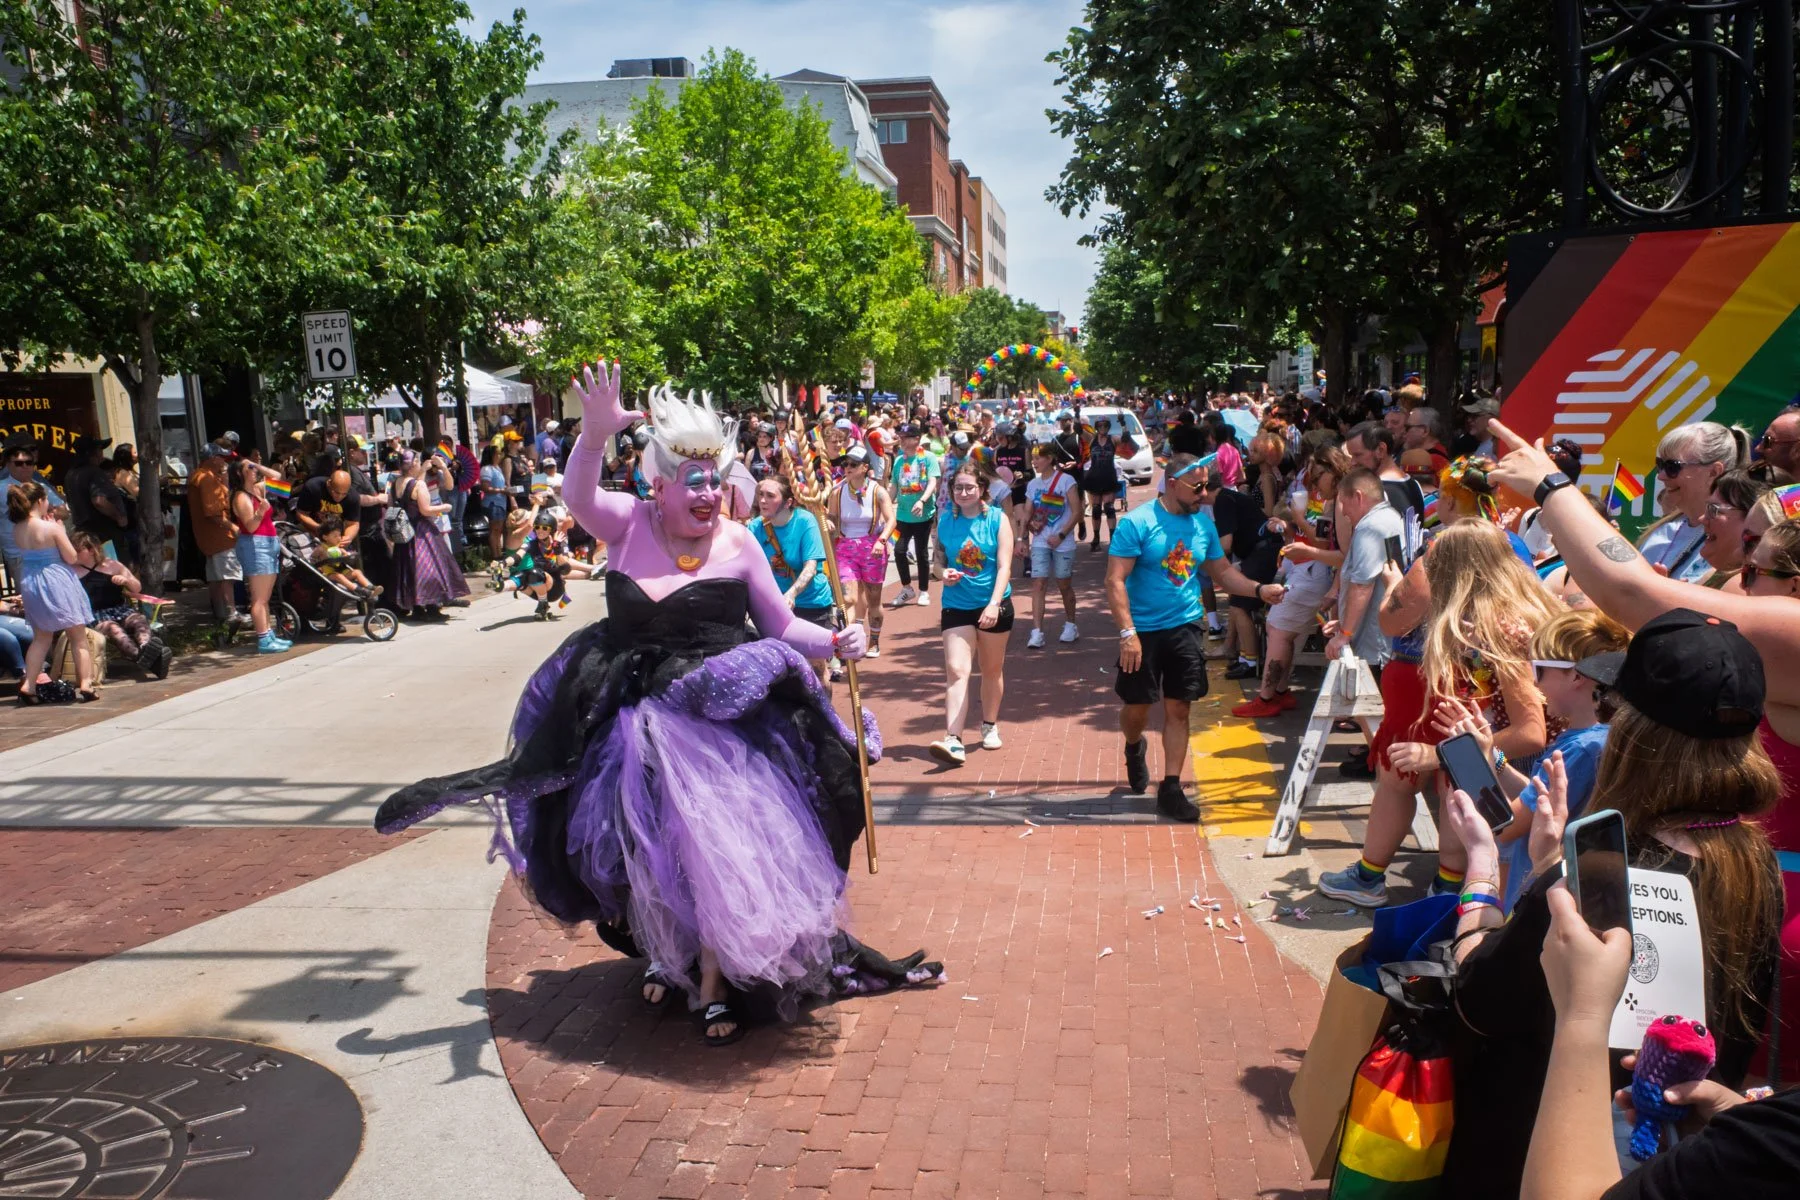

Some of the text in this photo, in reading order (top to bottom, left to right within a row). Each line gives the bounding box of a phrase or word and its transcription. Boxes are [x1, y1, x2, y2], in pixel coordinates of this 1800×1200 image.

[306, 318, 347, 330] SPEED
[312, 332, 344, 344] LIMIT
[315, 347, 347, 372] 10
[0, 398, 51, 410] PROPER
[1651, 886, 1683, 902] YOU.
